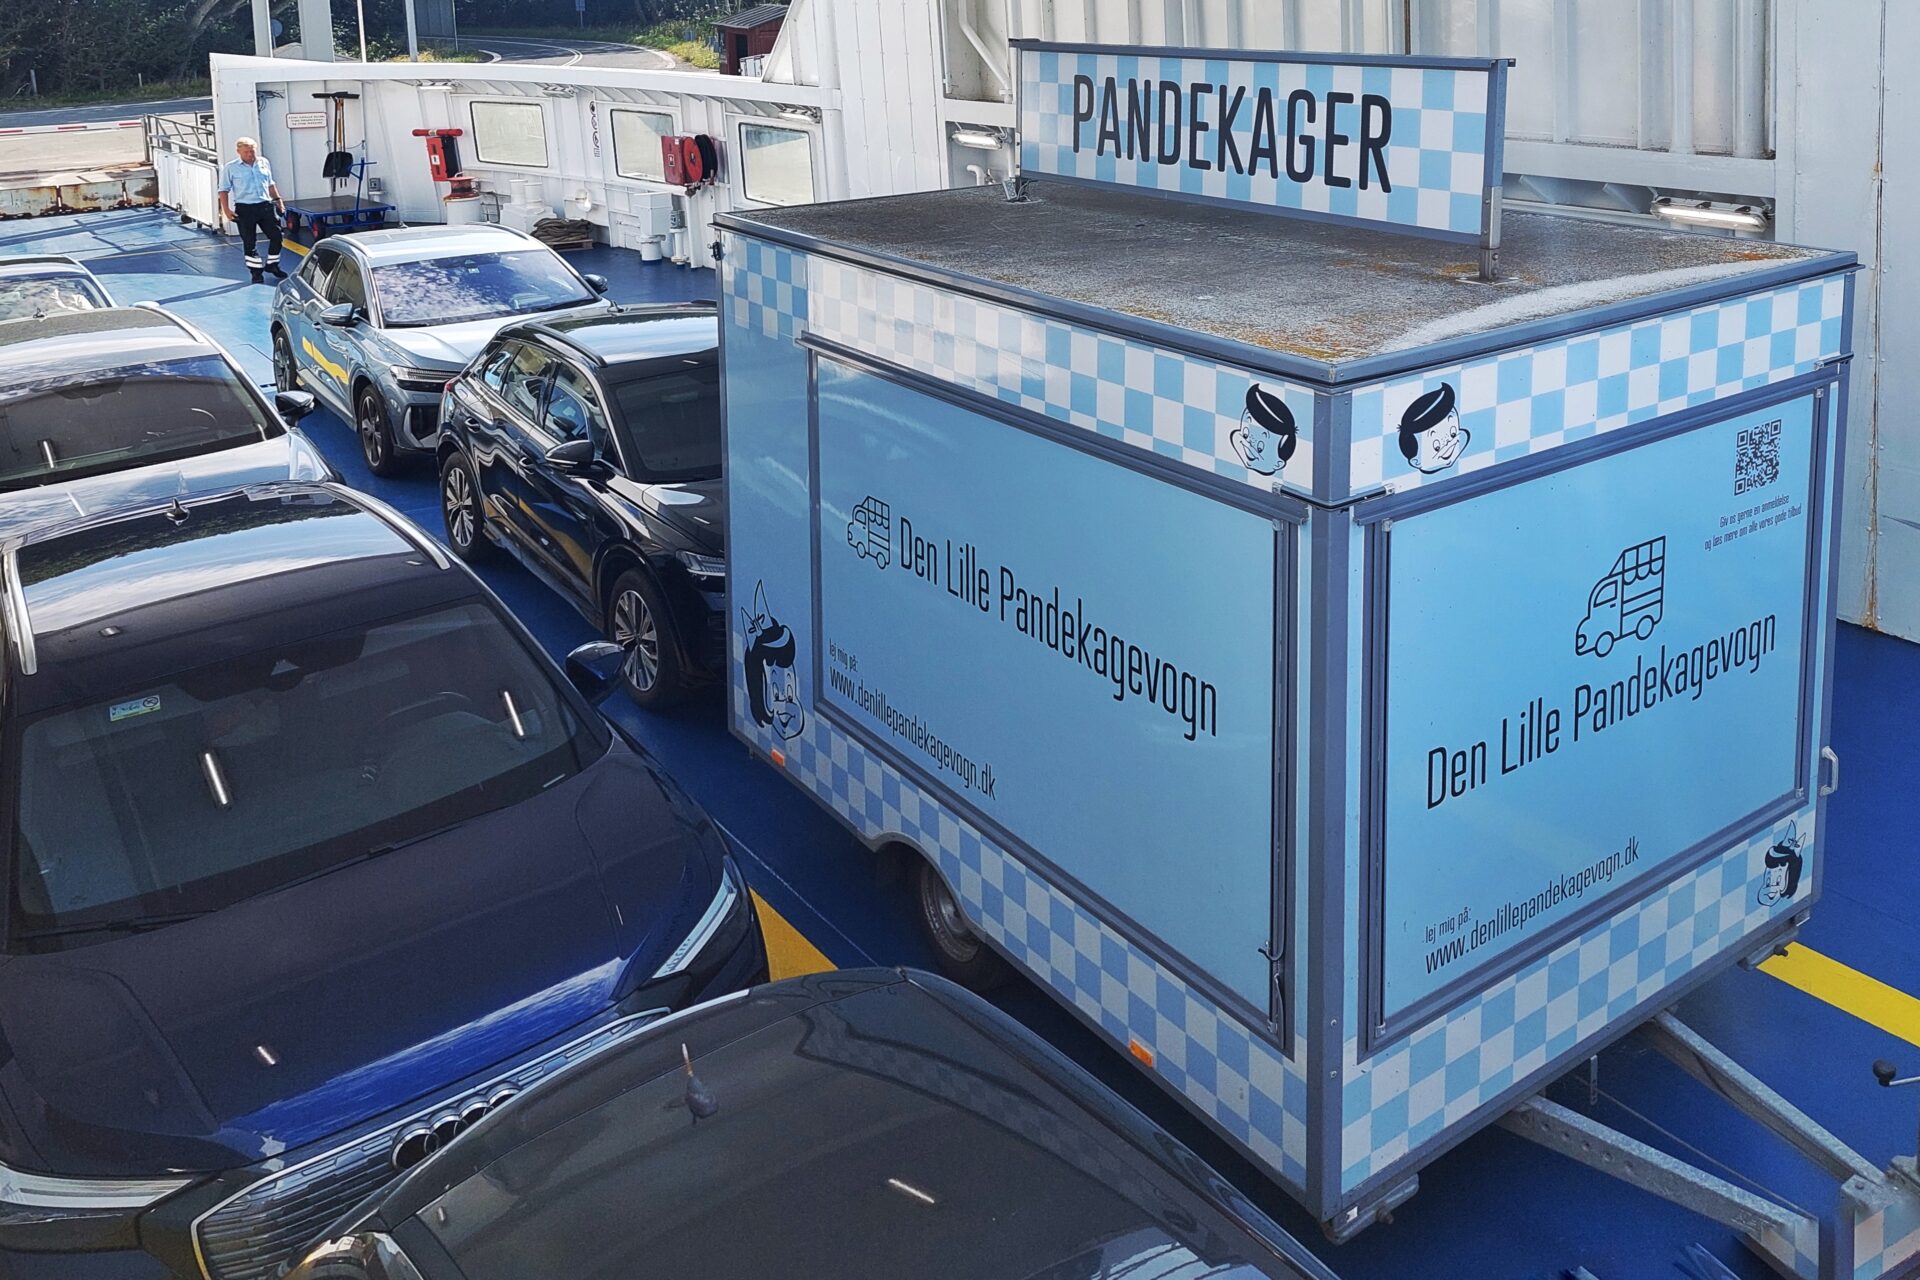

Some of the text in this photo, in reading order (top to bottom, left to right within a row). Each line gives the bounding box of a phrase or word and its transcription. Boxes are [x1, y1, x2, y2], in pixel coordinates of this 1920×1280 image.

[1073, 74, 1393, 194] PANDEKAGER
[1704, 540, 1712, 551] og
[1724, 530, 1738, 543] mere
[1739, 526, 1748, 537] om
[1749, 520, 1758, 534] alle
[1759, 516, 1774, 530] vores
[1775, 509, 1787, 526] gode
[1788, 502, 1802, 519] tilbud
[1737, 508, 1752, 524] gerne
[1754, 505, 1760, 516] en
[1762, 494, 1789, 512] anmeldelse
[837, 645, 848, 670] mig
[900, 516, 1218, 741] Den Lille Pandekagevogn
[830, 666, 996, 800] www.denlillepandekagevogn.dk
[1427, 613, 1776, 809] Den Lille Pandekagevogn
[1425, 836, 1640, 974] www.denlillepandekagevogn.dk
[1439, 915, 1455, 934] mig
[1458, 907, 1472, 928] på:
